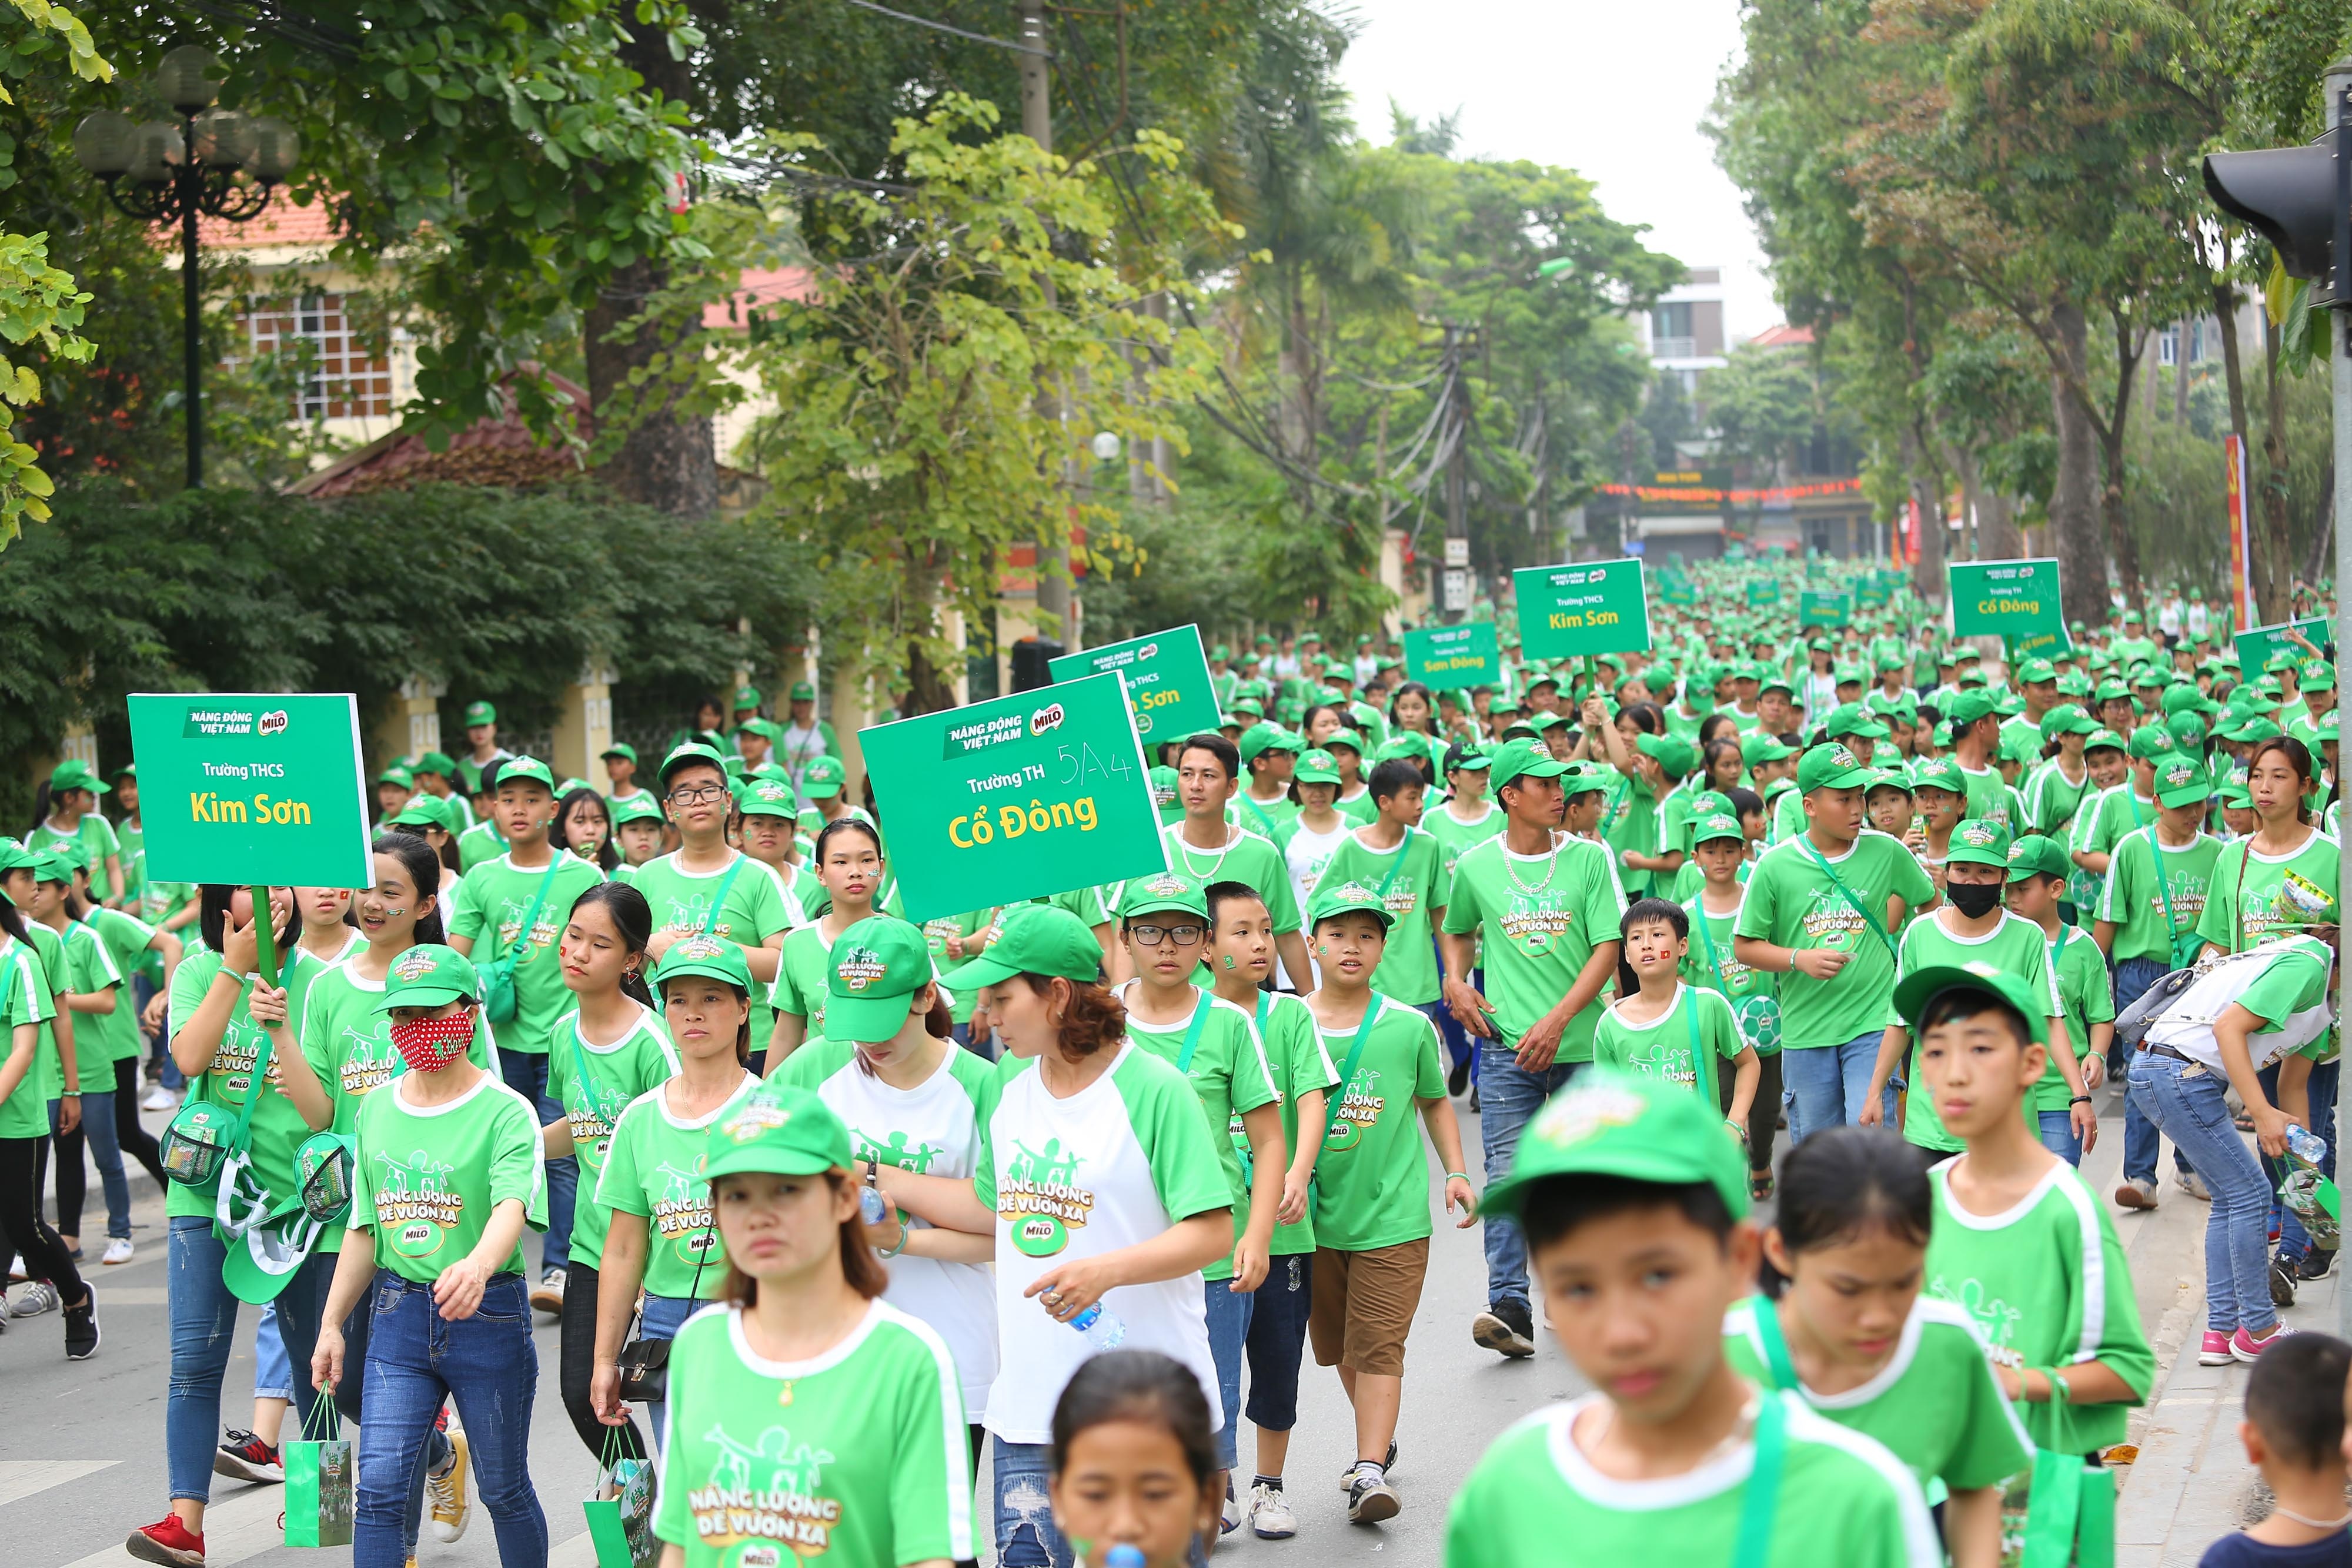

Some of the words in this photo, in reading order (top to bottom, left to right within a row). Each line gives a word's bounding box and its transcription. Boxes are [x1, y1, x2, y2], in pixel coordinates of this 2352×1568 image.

[1556, 597, 1583, 606] Trường
[1583, 594, 1603, 603] THCS
[2000, 599, 2039, 614] Đông
[1549, 612, 1582, 628] Kim
[1586, 610, 1618, 626] Sơn
[1141, 647, 1156, 657] MILO
[1117, 657, 1134, 666] NAM
[1135, 673, 1160, 685] THCS
[1141, 690, 1180, 710] Sơn
[191, 710, 221, 722] NĂNG
[222, 710, 253, 724] ĐỘNG
[262, 717, 285, 730] MILO
[1034, 710, 1061, 730] MILO
[199, 723, 225, 735] VIỆT
[225, 724, 250, 734] NAM
[948, 723, 985, 741] NĂNG
[987, 715, 1022, 733] ĐỘNG
[961, 735, 990, 750] VIỆT
[992, 728, 1022, 744] NAM
[1057, 741, 1132, 786] 5A4
[202, 763, 248, 780] Trường
[249, 763, 285, 777] THCS
[967, 773, 1023, 794] Trường
[1022, 763, 1046, 781] TH
[190, 792, 248, 823] Kim
[254, 793, 311, 824] Sơn
[948, 805, 994, 848] Cổ
[999, 796, 1098, 839] Đông
[1500, 912, 1531, 925] NĂNG
[1532, 910, 1571, 921] LƯỢNG
[1802, 911, 1832, 924] NĂNG
[1833, 908, 1862, 919] LƯỢN
[1552, 921, 1565, 932] XA
[1852, 921, 1865, 930] XA
[1735, 977, 1748, 985] MILO
[339, 1060, 377, 1076] NĂNG
[228, 1080, 249, 1089] MILO
[195, 1114, 207, 1122] MILO
[567, 1109, 597, 1124] NĂNG
[1358, 1110, 1376, 1122] XA
[1329, 1127, 1348, 1136] MILO
[375, 1190, 412, 1206] NĂNG
[412, 1190, 462, 1206] LƯỢNG
[1036, 1181, 1091, 1206] LƯỢNG
[395, 1202, 439, 1220] VƯƠN
[439, 1208, 458, 1223] XA
[1016, 1193, 1063, 1218] VƯƠN
[1064, 1205, 1085, 1223] XA
[405, 1230, 428, 1240] MILO
[1025, 1226, 1051, 1236] MILO
[689, 1485, 754, 1511] NĂNG
[756, 1489, 838, 1520] LƯỢNG
[796, 1521, 828, 1546] XA
